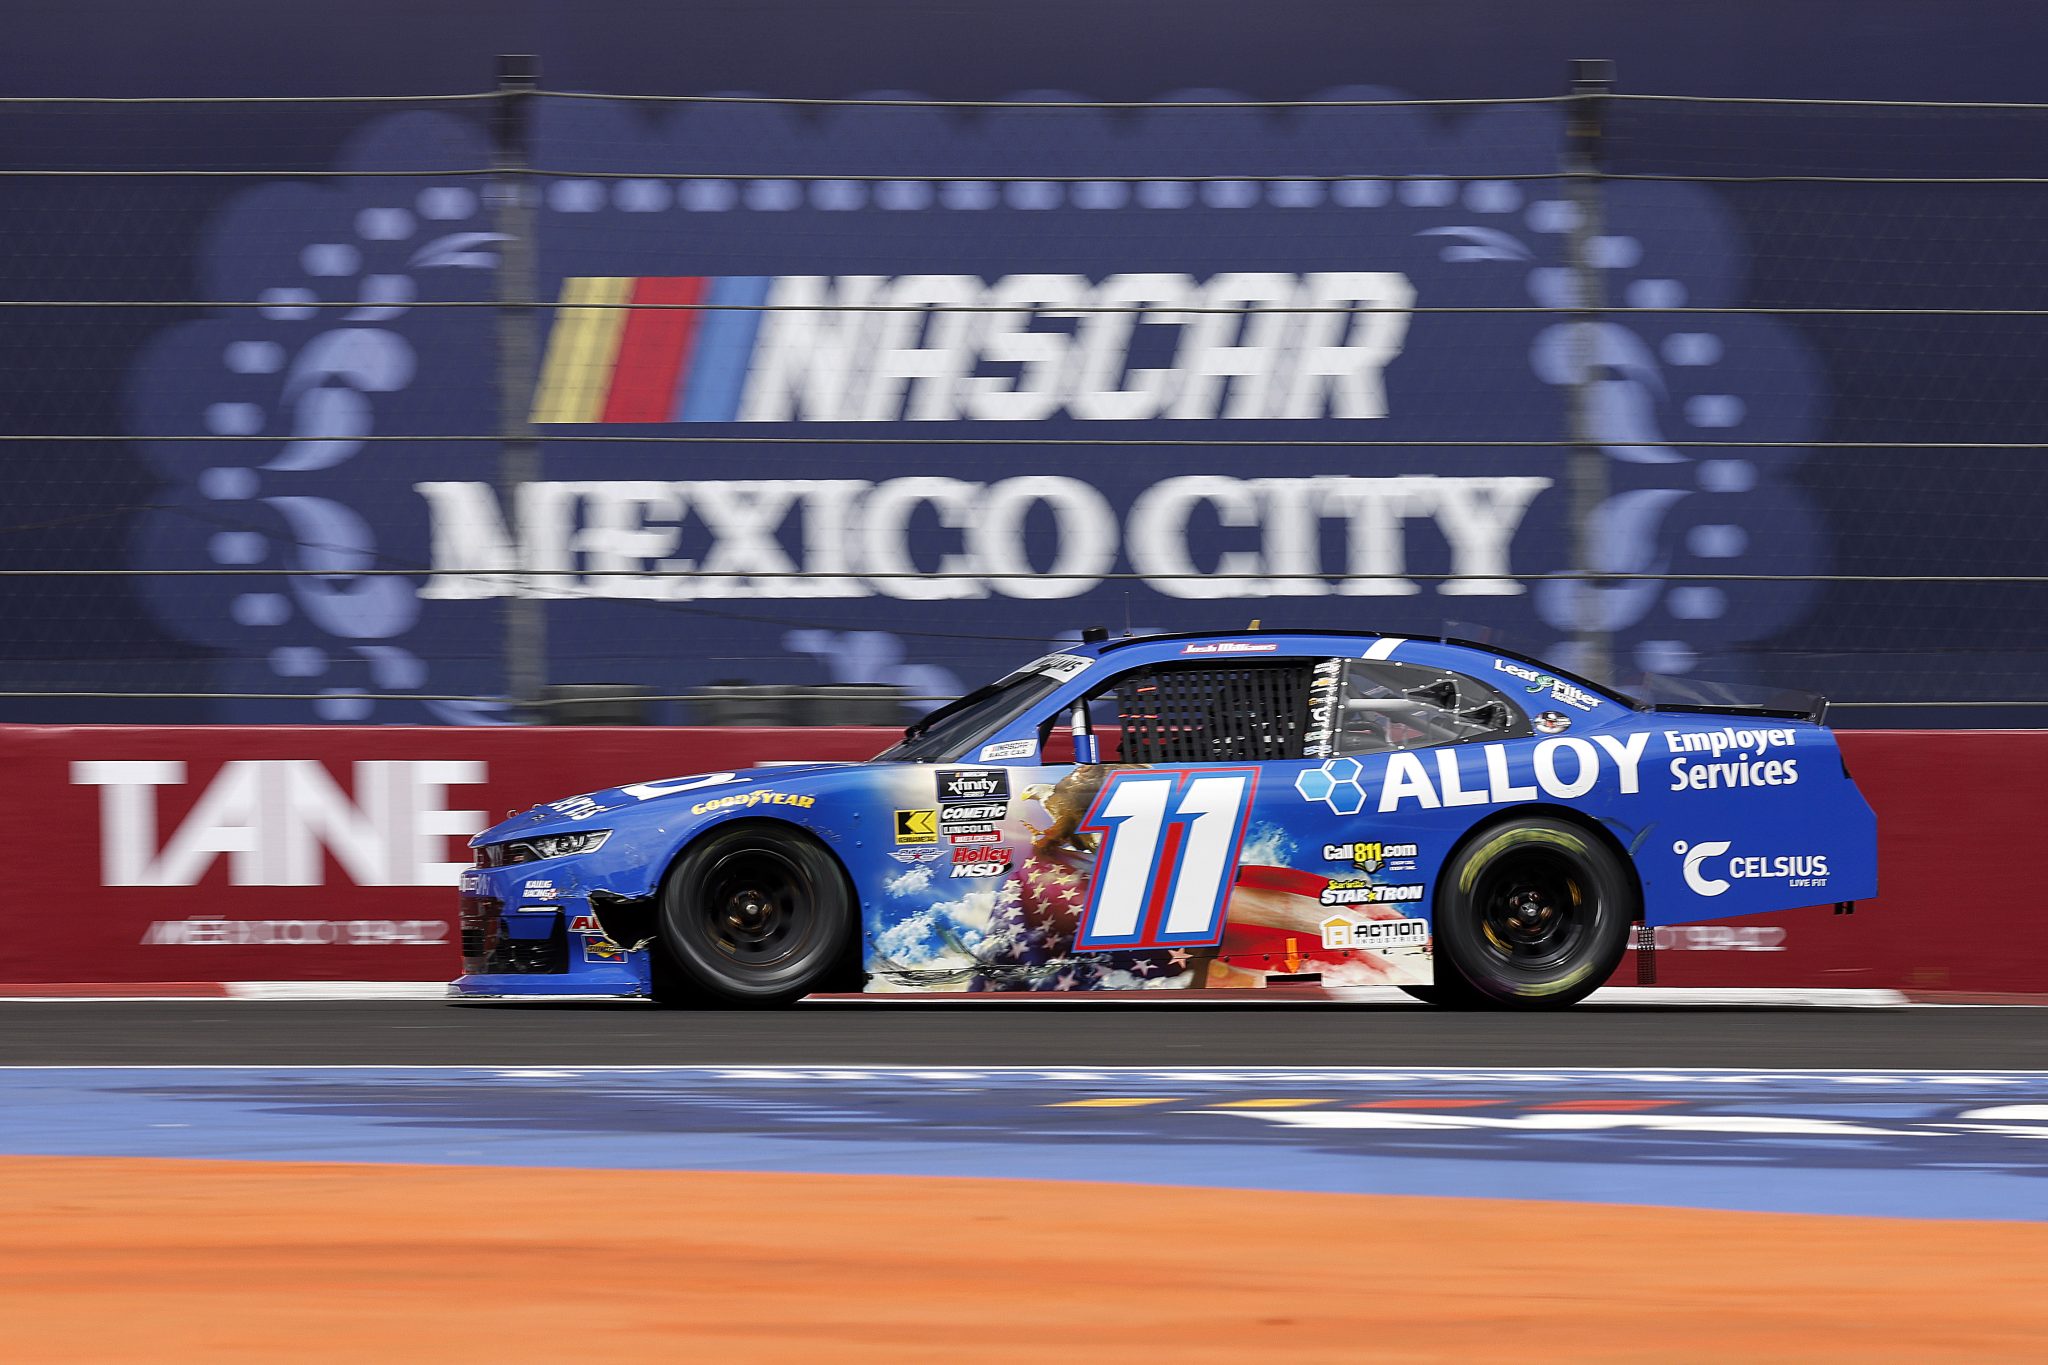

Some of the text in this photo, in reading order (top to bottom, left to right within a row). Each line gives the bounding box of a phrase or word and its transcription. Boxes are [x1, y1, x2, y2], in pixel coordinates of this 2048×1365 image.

[734, 272, 1418, 422] NASCAR
[412, 474, 1553, 600] MEXICO CITY
[1665, 728, 1796, 757] Employer
[948, 778, 998, 794] xfinity
[1377, 732, 1651, 813] ALLOY
[1670, 753, 1798, 791] Services
[691, 790, 815, 815] GOODYEAR
[69, 760, 488, 886] TANE
[950, 863, 1004, 878] MSD
[951, 846, 1013, 866] Holley
[1079, 770, 1256, 946] 11
[1789, 878, 1828, 887] LIVE FIT
[1355, 922, 1424, 938] ACTION
